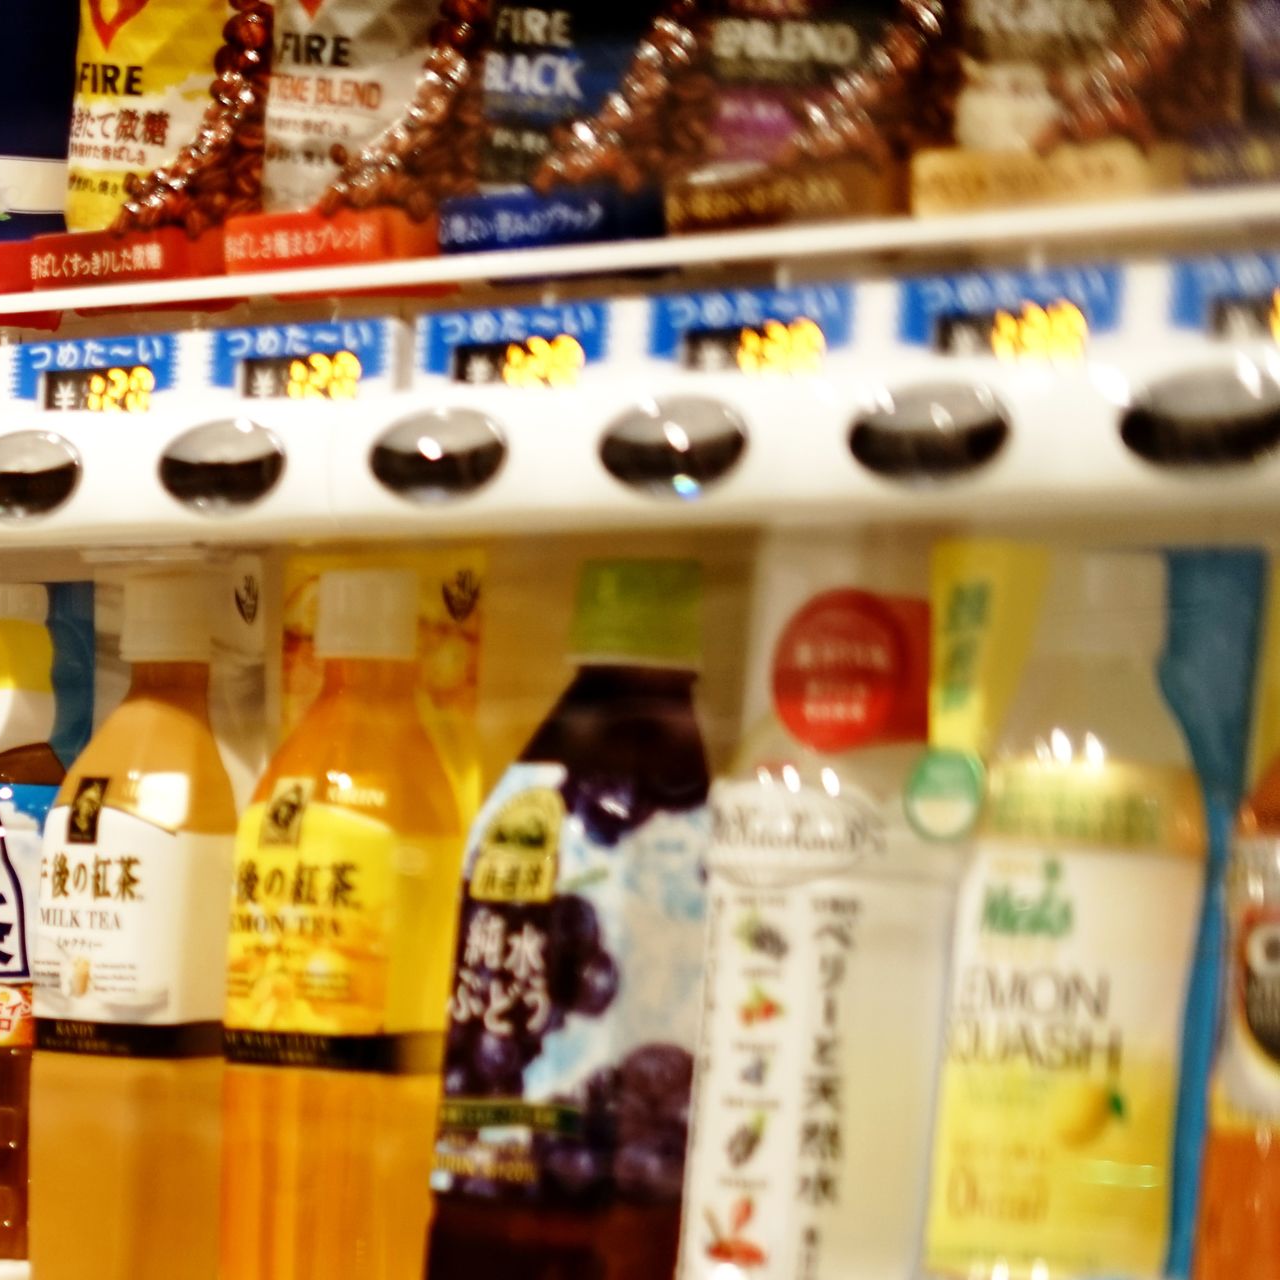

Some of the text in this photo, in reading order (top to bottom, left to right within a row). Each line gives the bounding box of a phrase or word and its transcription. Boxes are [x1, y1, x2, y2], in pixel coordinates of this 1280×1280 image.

[280, 34, 351, 67] FIRE
[79, 62, 144, 96] FIRE
[316, 78, 383, 110] BLEND
[40, 908, 122, 930] MILK TEA
[464, 908, 546, 979] 純水
